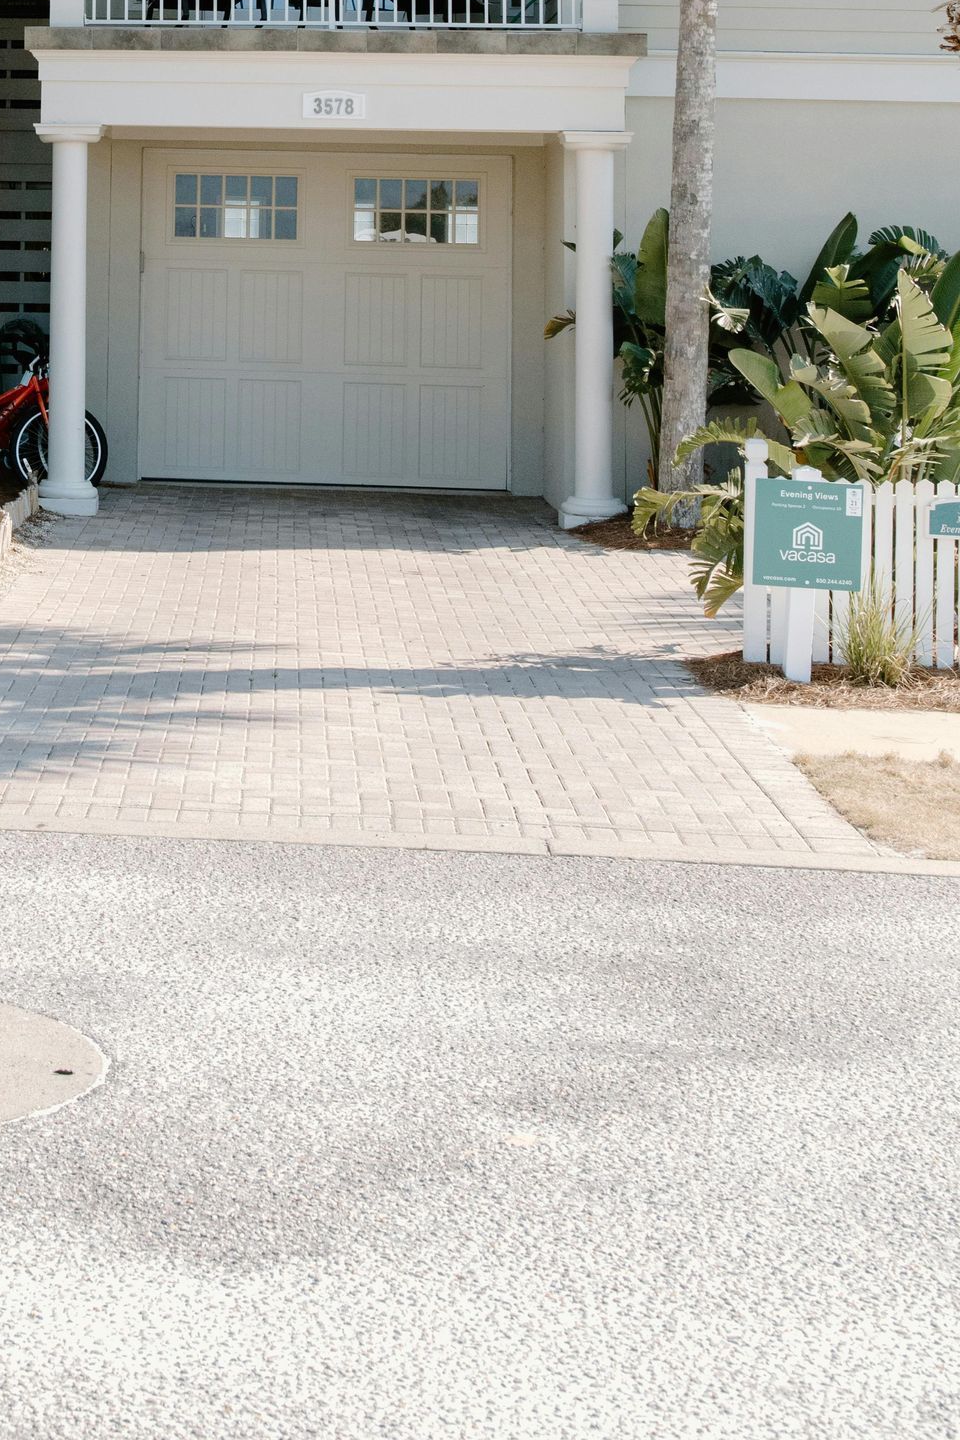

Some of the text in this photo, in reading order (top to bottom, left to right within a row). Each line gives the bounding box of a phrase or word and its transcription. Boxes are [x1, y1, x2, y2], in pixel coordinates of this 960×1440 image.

[313, 97, 354, 115] 3578
[780, 489, 813, 501] Evening
[815, 492, 839, 501] Views
[779, 549, 836, 564] vacasa
